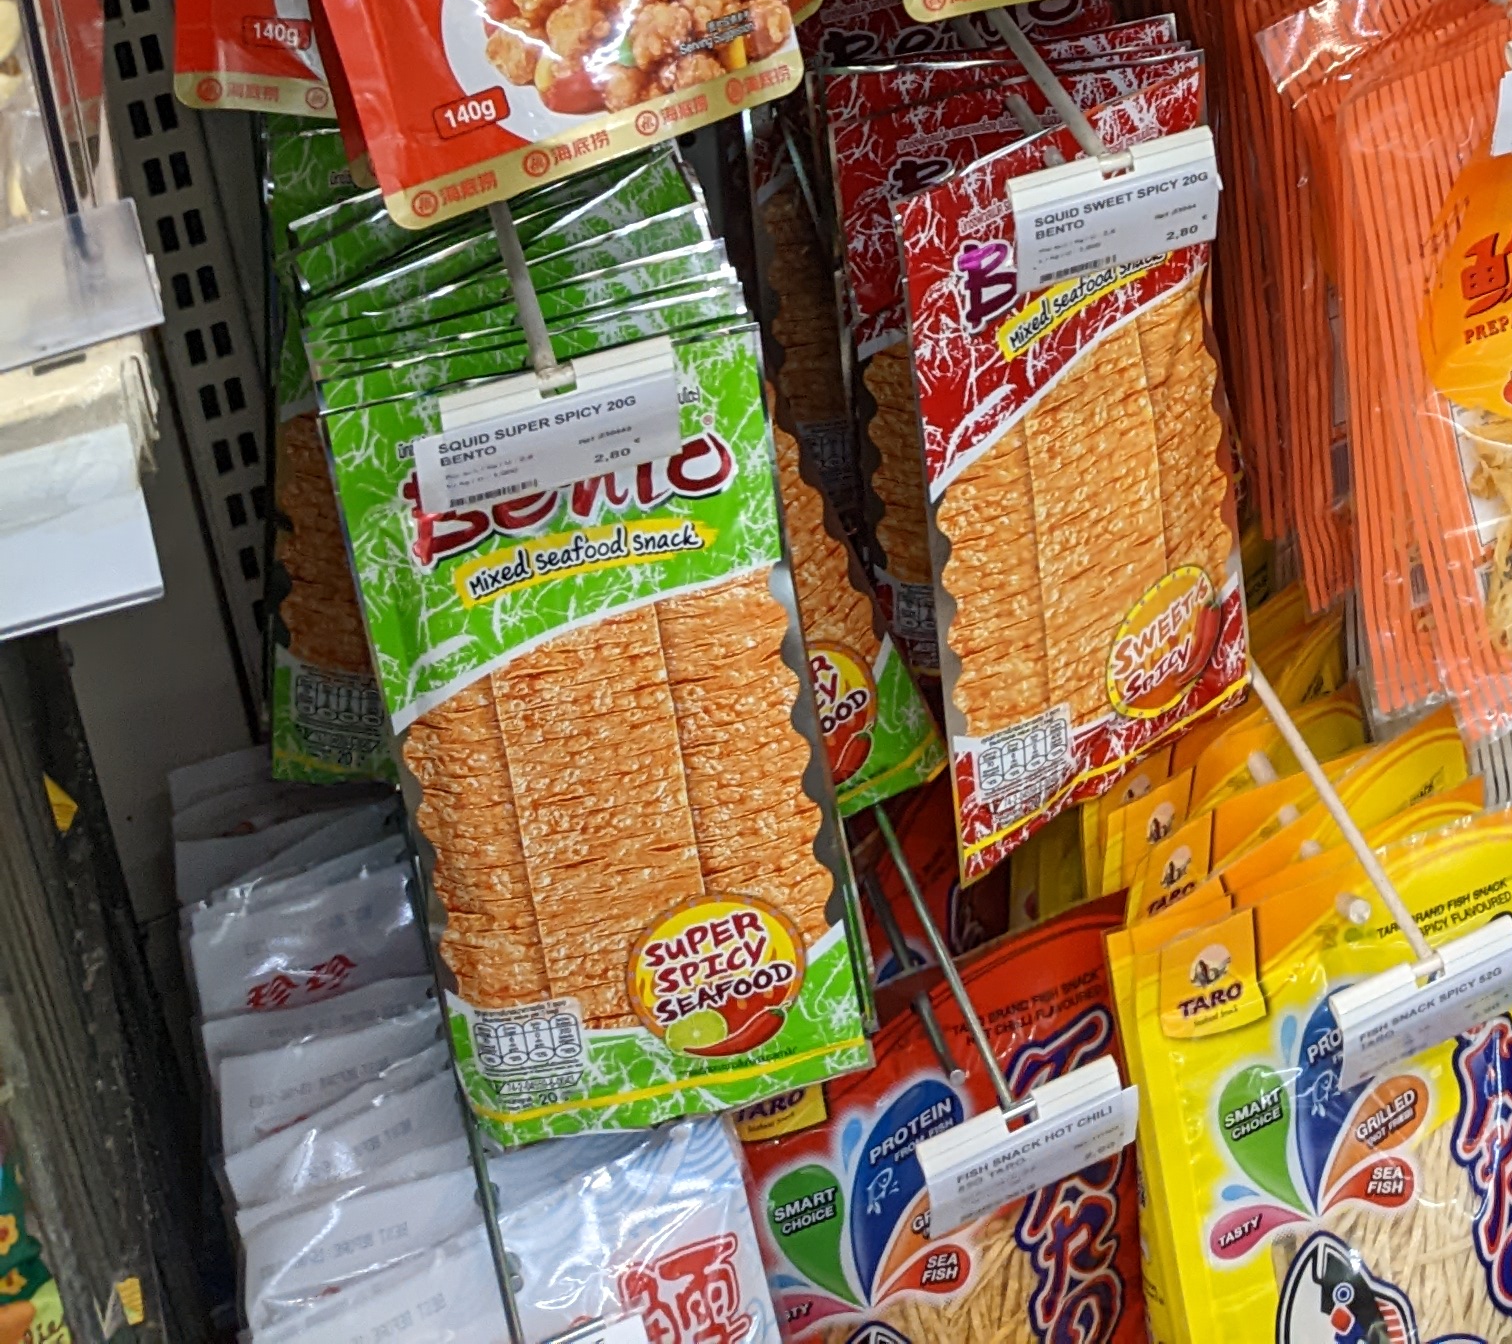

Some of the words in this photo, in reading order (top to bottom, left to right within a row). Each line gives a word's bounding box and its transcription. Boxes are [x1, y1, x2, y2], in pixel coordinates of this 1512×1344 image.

[252, 22, 300, 50] 140g
[442, 98, 498, 128] 140g
[1034, 206, 1080, 228] SQUID
[1082, 191, 1134, 214] SWEET
[1136, 179, 1179, 200] SPICY
[1181, 170, 1209, 186] 20G
[1034, 219, 1085, 241] BENTO
[437, 433, 491, 455] SQUID
[493, 418, 551, 442] SUPER
[553, 405, 603, 427] SPICY
[605, 394, 638, 413] 20G
[438, 445, 498, 468] BENTO
[469, 549, 532, 598] Mixed
[536, 527, 628, 571] seafood
[632, 522, 706, 552] snack
[643, 908, 767, 968] SUPER
[657, 935, 769, 995] SPICY
[655, 960, 795, 1023] SEAFOOD
[1178, 982, 1246, 1019] TARO
[1223, 1089, 1284, 1132] SMART
[1230, 1106, 1284, 1141] CHOICE
[1354, 1087, 1418, 1141] GRILLED
[868, 1097, 954, 1165] PROTEIN
[955, 1162, 992, 1183] FISH
[992, 1136, 1043, 1166] SNACK
[1044, 1122, 1075, 1144] HOT
[1075, 1104, 1115, 1127] CHILI
[1366, 1179, 1405, 1196] FISH
[1370, 1166, 1405, 1181] SEA
[772, 1187, 838, 1224] SMART
[780, 1205, 837, 1236] CHOICE
[1216, 1215, 1264, 1250] TASTY
[920, 1266, 961, 1286] FISH
[925, 1254, 960, 1276] SEA
